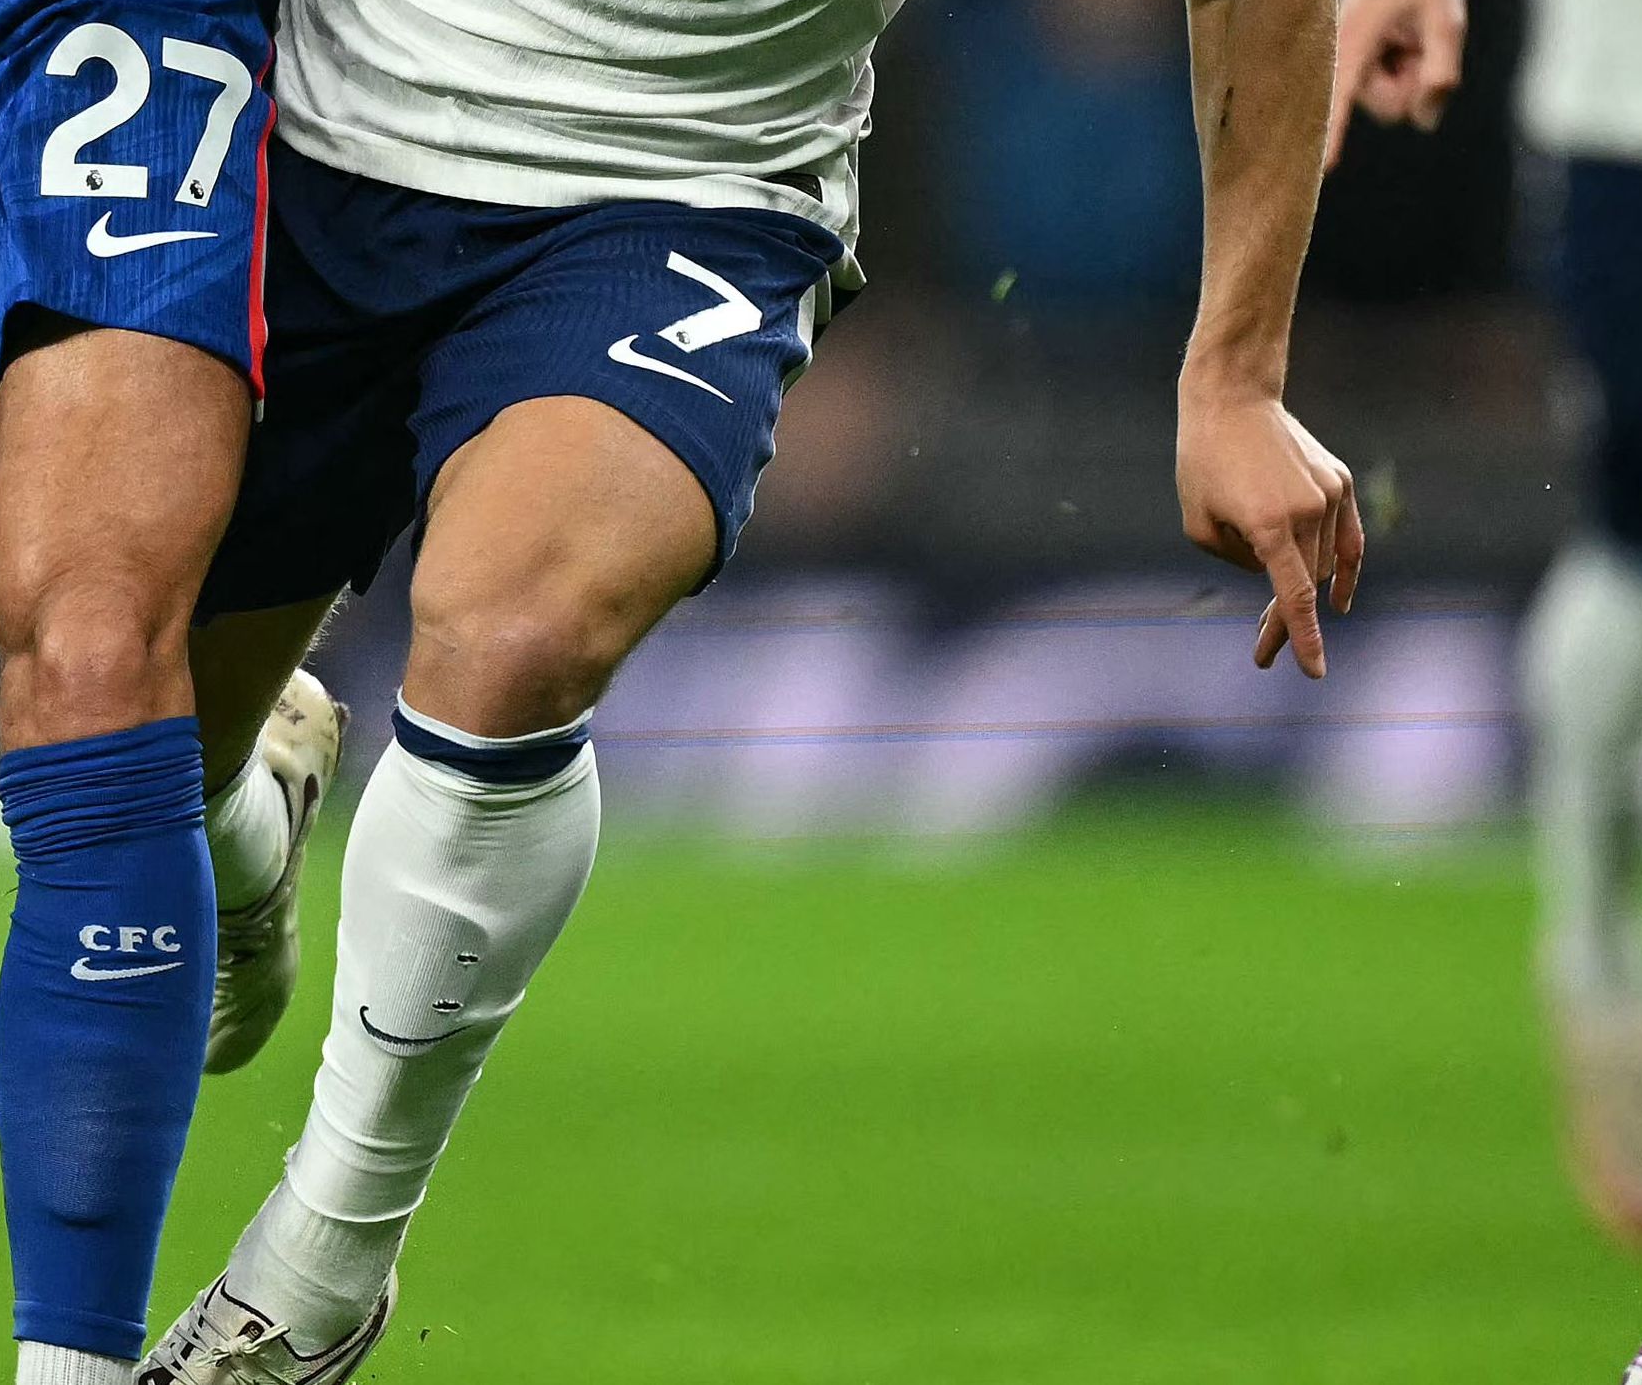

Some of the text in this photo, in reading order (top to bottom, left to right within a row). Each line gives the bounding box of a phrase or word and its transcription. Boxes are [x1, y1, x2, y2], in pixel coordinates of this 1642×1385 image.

[40, 22, 253, 208] 27
[656, 250, 763, 354] 7
[79, 924, 181, 953] CFC
